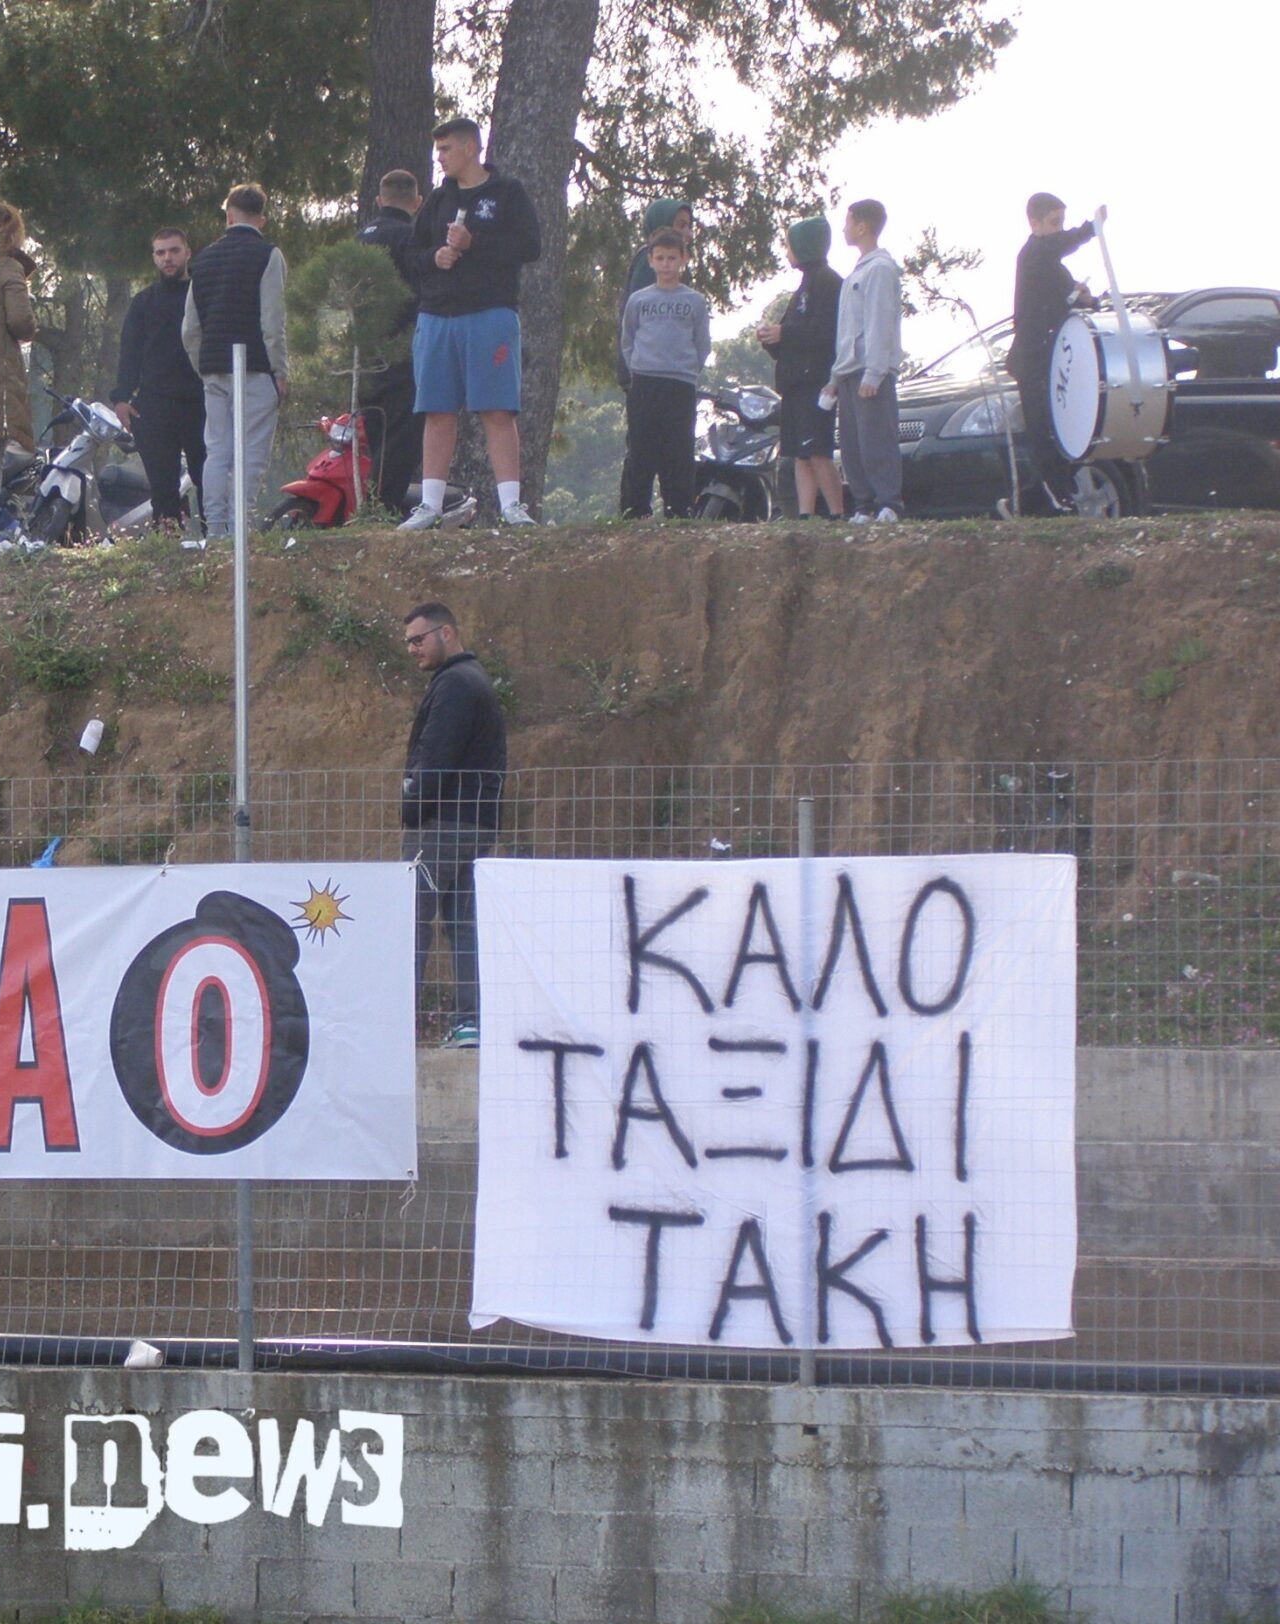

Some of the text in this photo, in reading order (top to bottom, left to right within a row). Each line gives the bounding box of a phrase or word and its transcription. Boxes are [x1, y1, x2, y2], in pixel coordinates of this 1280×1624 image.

[641, 303, 692, 316] HACKED
[623, 872, 976, 1018] ΚΑΛΟ
[517, 1031, 972, 1183] ΤΑΞΙΔΙ
[608, 1205, 983, 1348] ΤΑΚΗ
